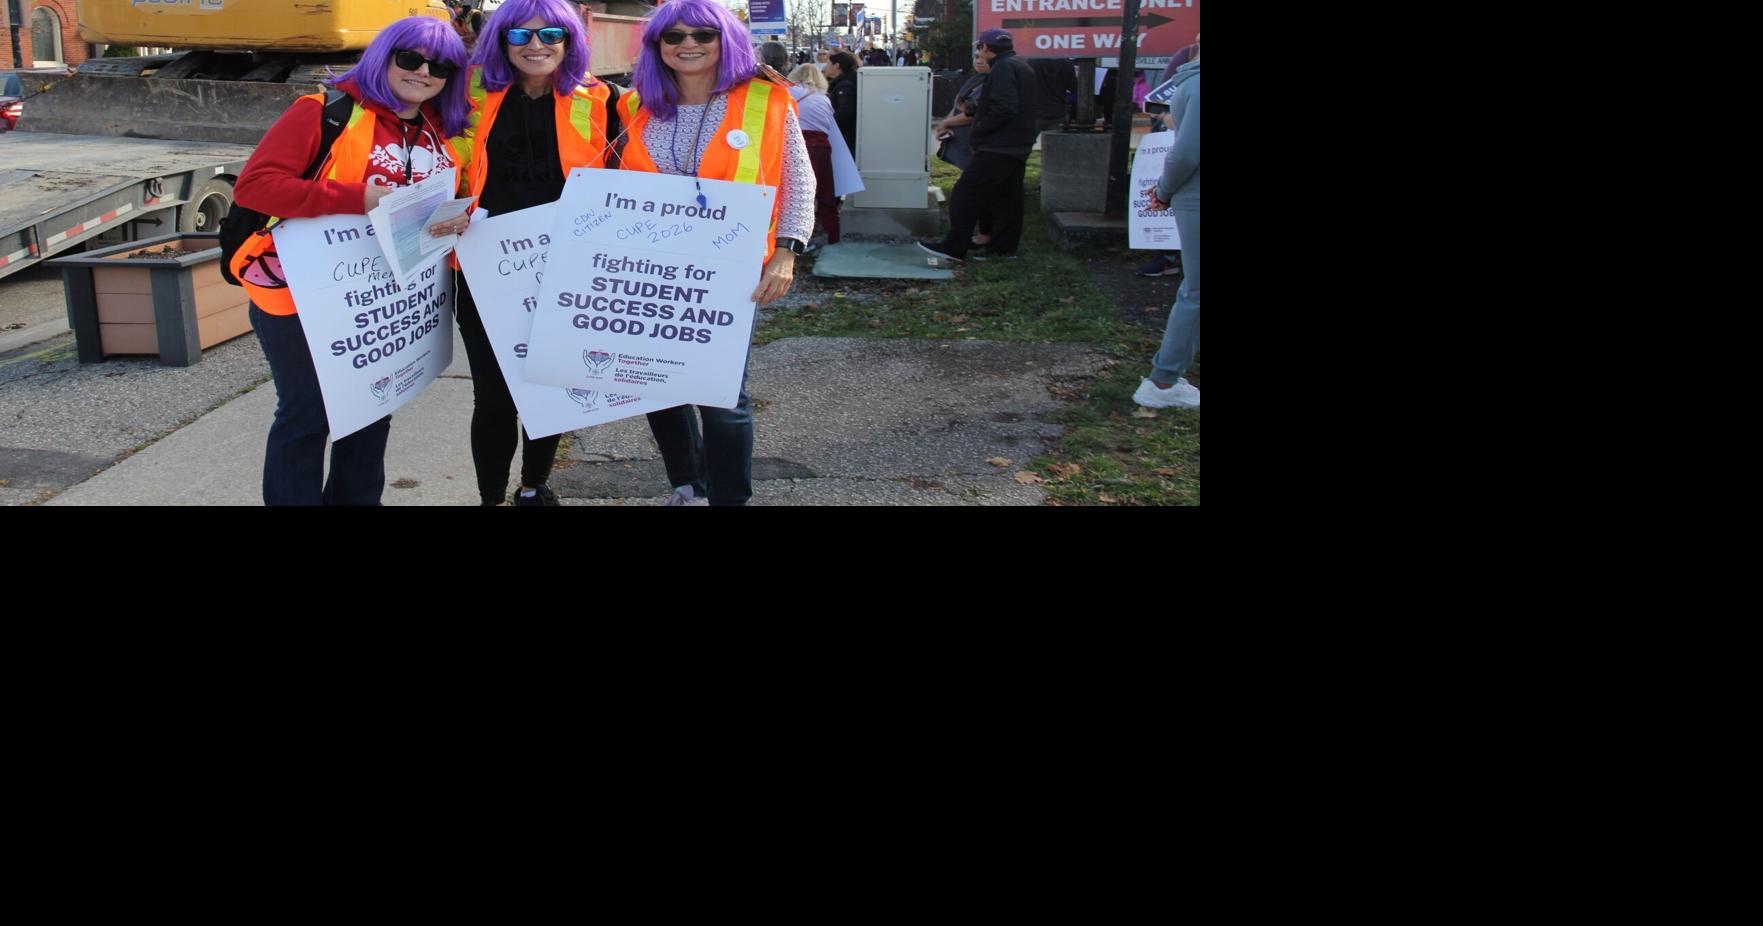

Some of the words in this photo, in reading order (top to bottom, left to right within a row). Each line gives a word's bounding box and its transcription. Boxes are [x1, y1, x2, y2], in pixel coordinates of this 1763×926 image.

[991, 0, 1121, 12] ENTRANCE
[1035, 34, 1085, 49] ONE
[605, 192, 637, 211] I'm
[642, 201, 655, 213] a
[660, 205, 727, 221] proud
[1159, 208, 1176, 217] JOB
[324, 225, 360, 245] I'm
[366, 224, 376, 236] a
[573, 211, 613, 238] CITIZEN
[616, 219, 658, 241] CUPE
[647, 221, 694, 244] 2026
[711, 221, 751, 250] MOM
[500, 238, 534, 255] I'm
[538, 233, 551, 246] a
[333, 255, 382, 282] CUPE
[498, 251, 549, 276] CUPE
[592, 252, 679, 281] fighting
[684, 264, 716, 282] for
[591, 276, 709, 304] STUDENT
[354, 283, 435, 329] STUDENT
[557, 292, 675, 320] SUCCESS
[679, 307, 734, 327] AND
[330, 310, 421, 357] SUCCESS
[423, 291, 447, 319] AND
[572, 313, 645, 336] GOOD
[649, 323, 712, 344] JOBS
[352, 336, 406, 369] GOOD
[409, 314, 440, 345] JOBS
[618, 353, 654, 362] Education
[656, 358, 685, 366] Workers
[618, 359, 649, 367] Together
[613, 378, 648, 386] solidaires
[629, 369, 669, 379] travailleurs
